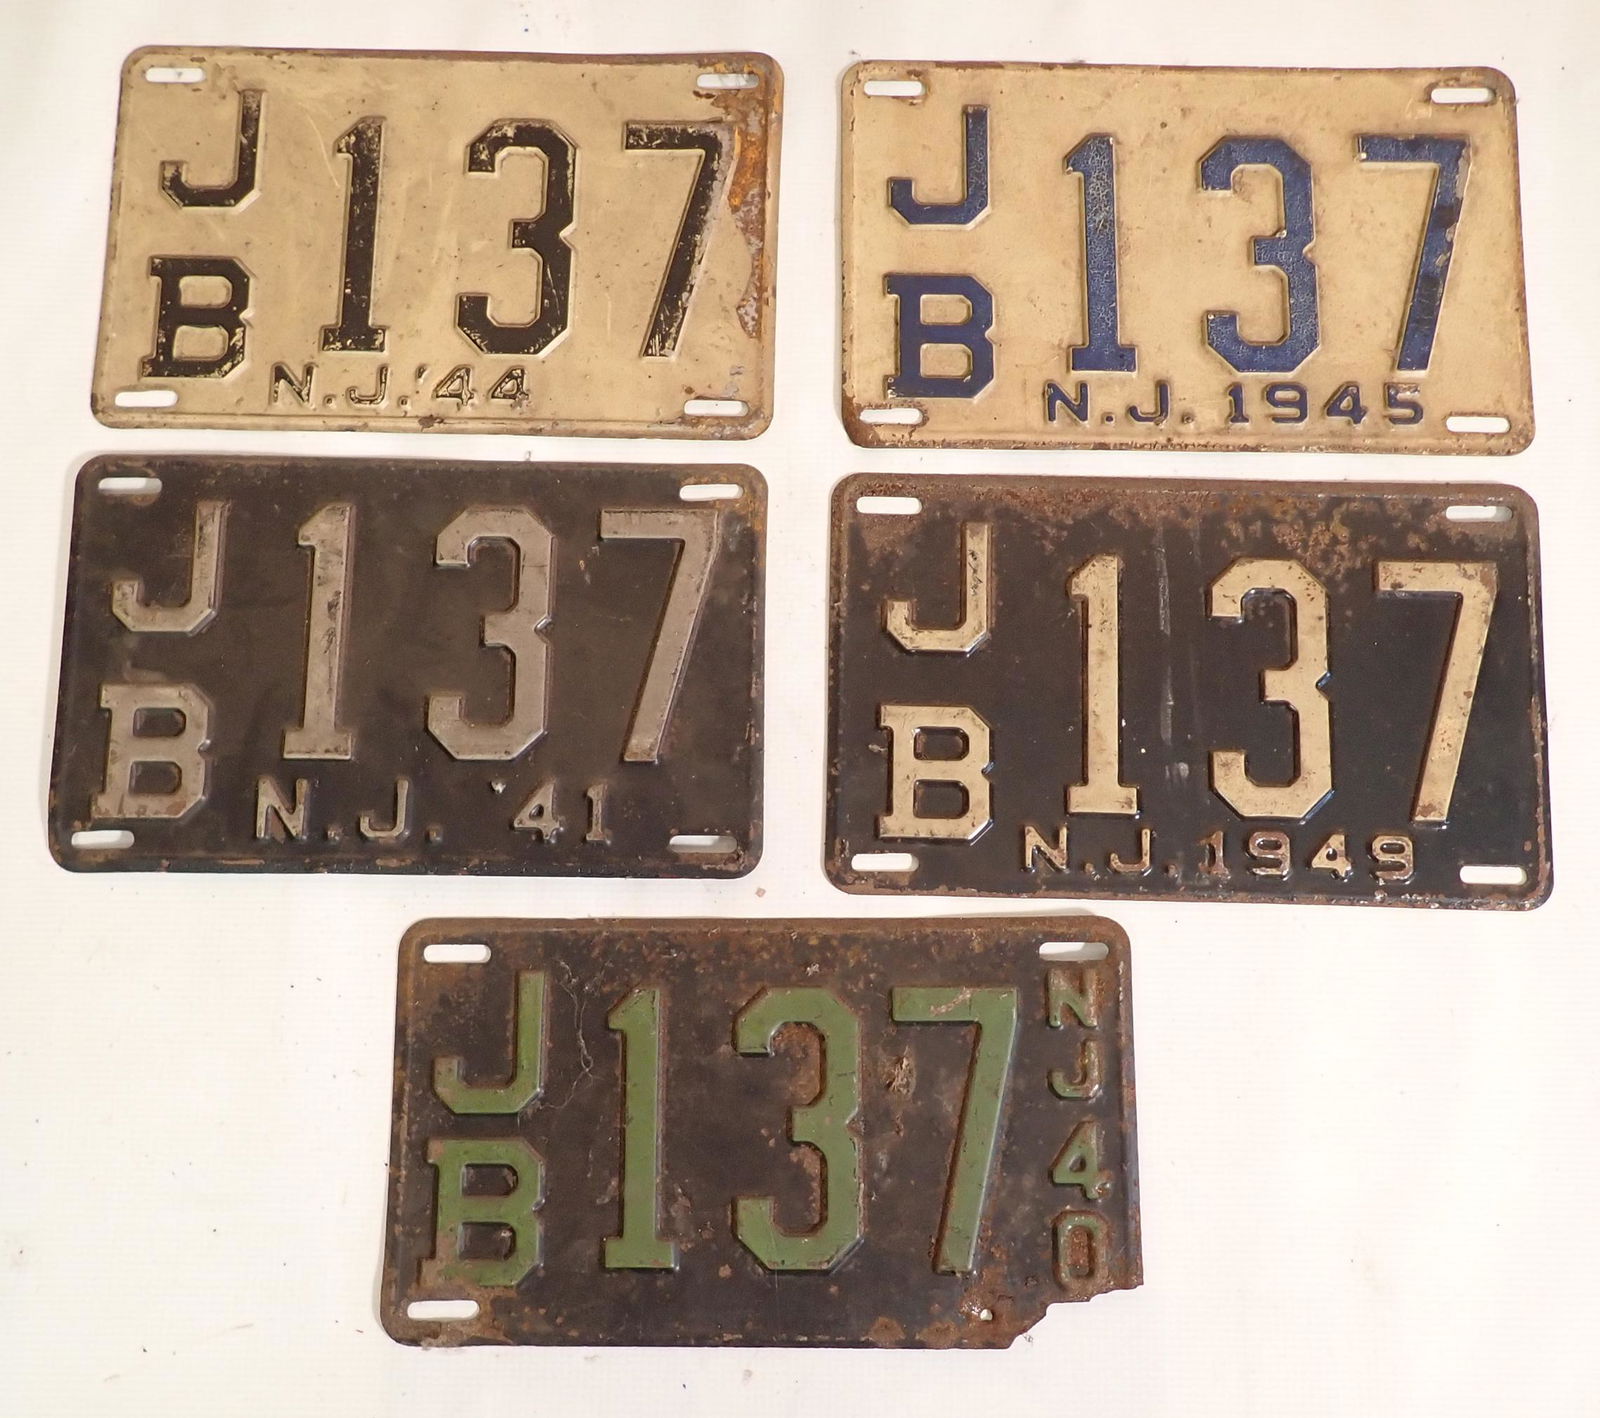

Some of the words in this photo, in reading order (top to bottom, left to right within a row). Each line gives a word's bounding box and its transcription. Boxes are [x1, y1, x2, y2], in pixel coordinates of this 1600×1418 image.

[320, 114, 732, 361] 137
[1062, 132, 1470, 374] 137
[1228, 382, 1427, 427] 1945
[281, 503, 724, 764] 137
[1066, 552, 1498, 824] 137
[1198, 829, 1417, 883] 1949
[602, 985, 1022, 1276] 137
